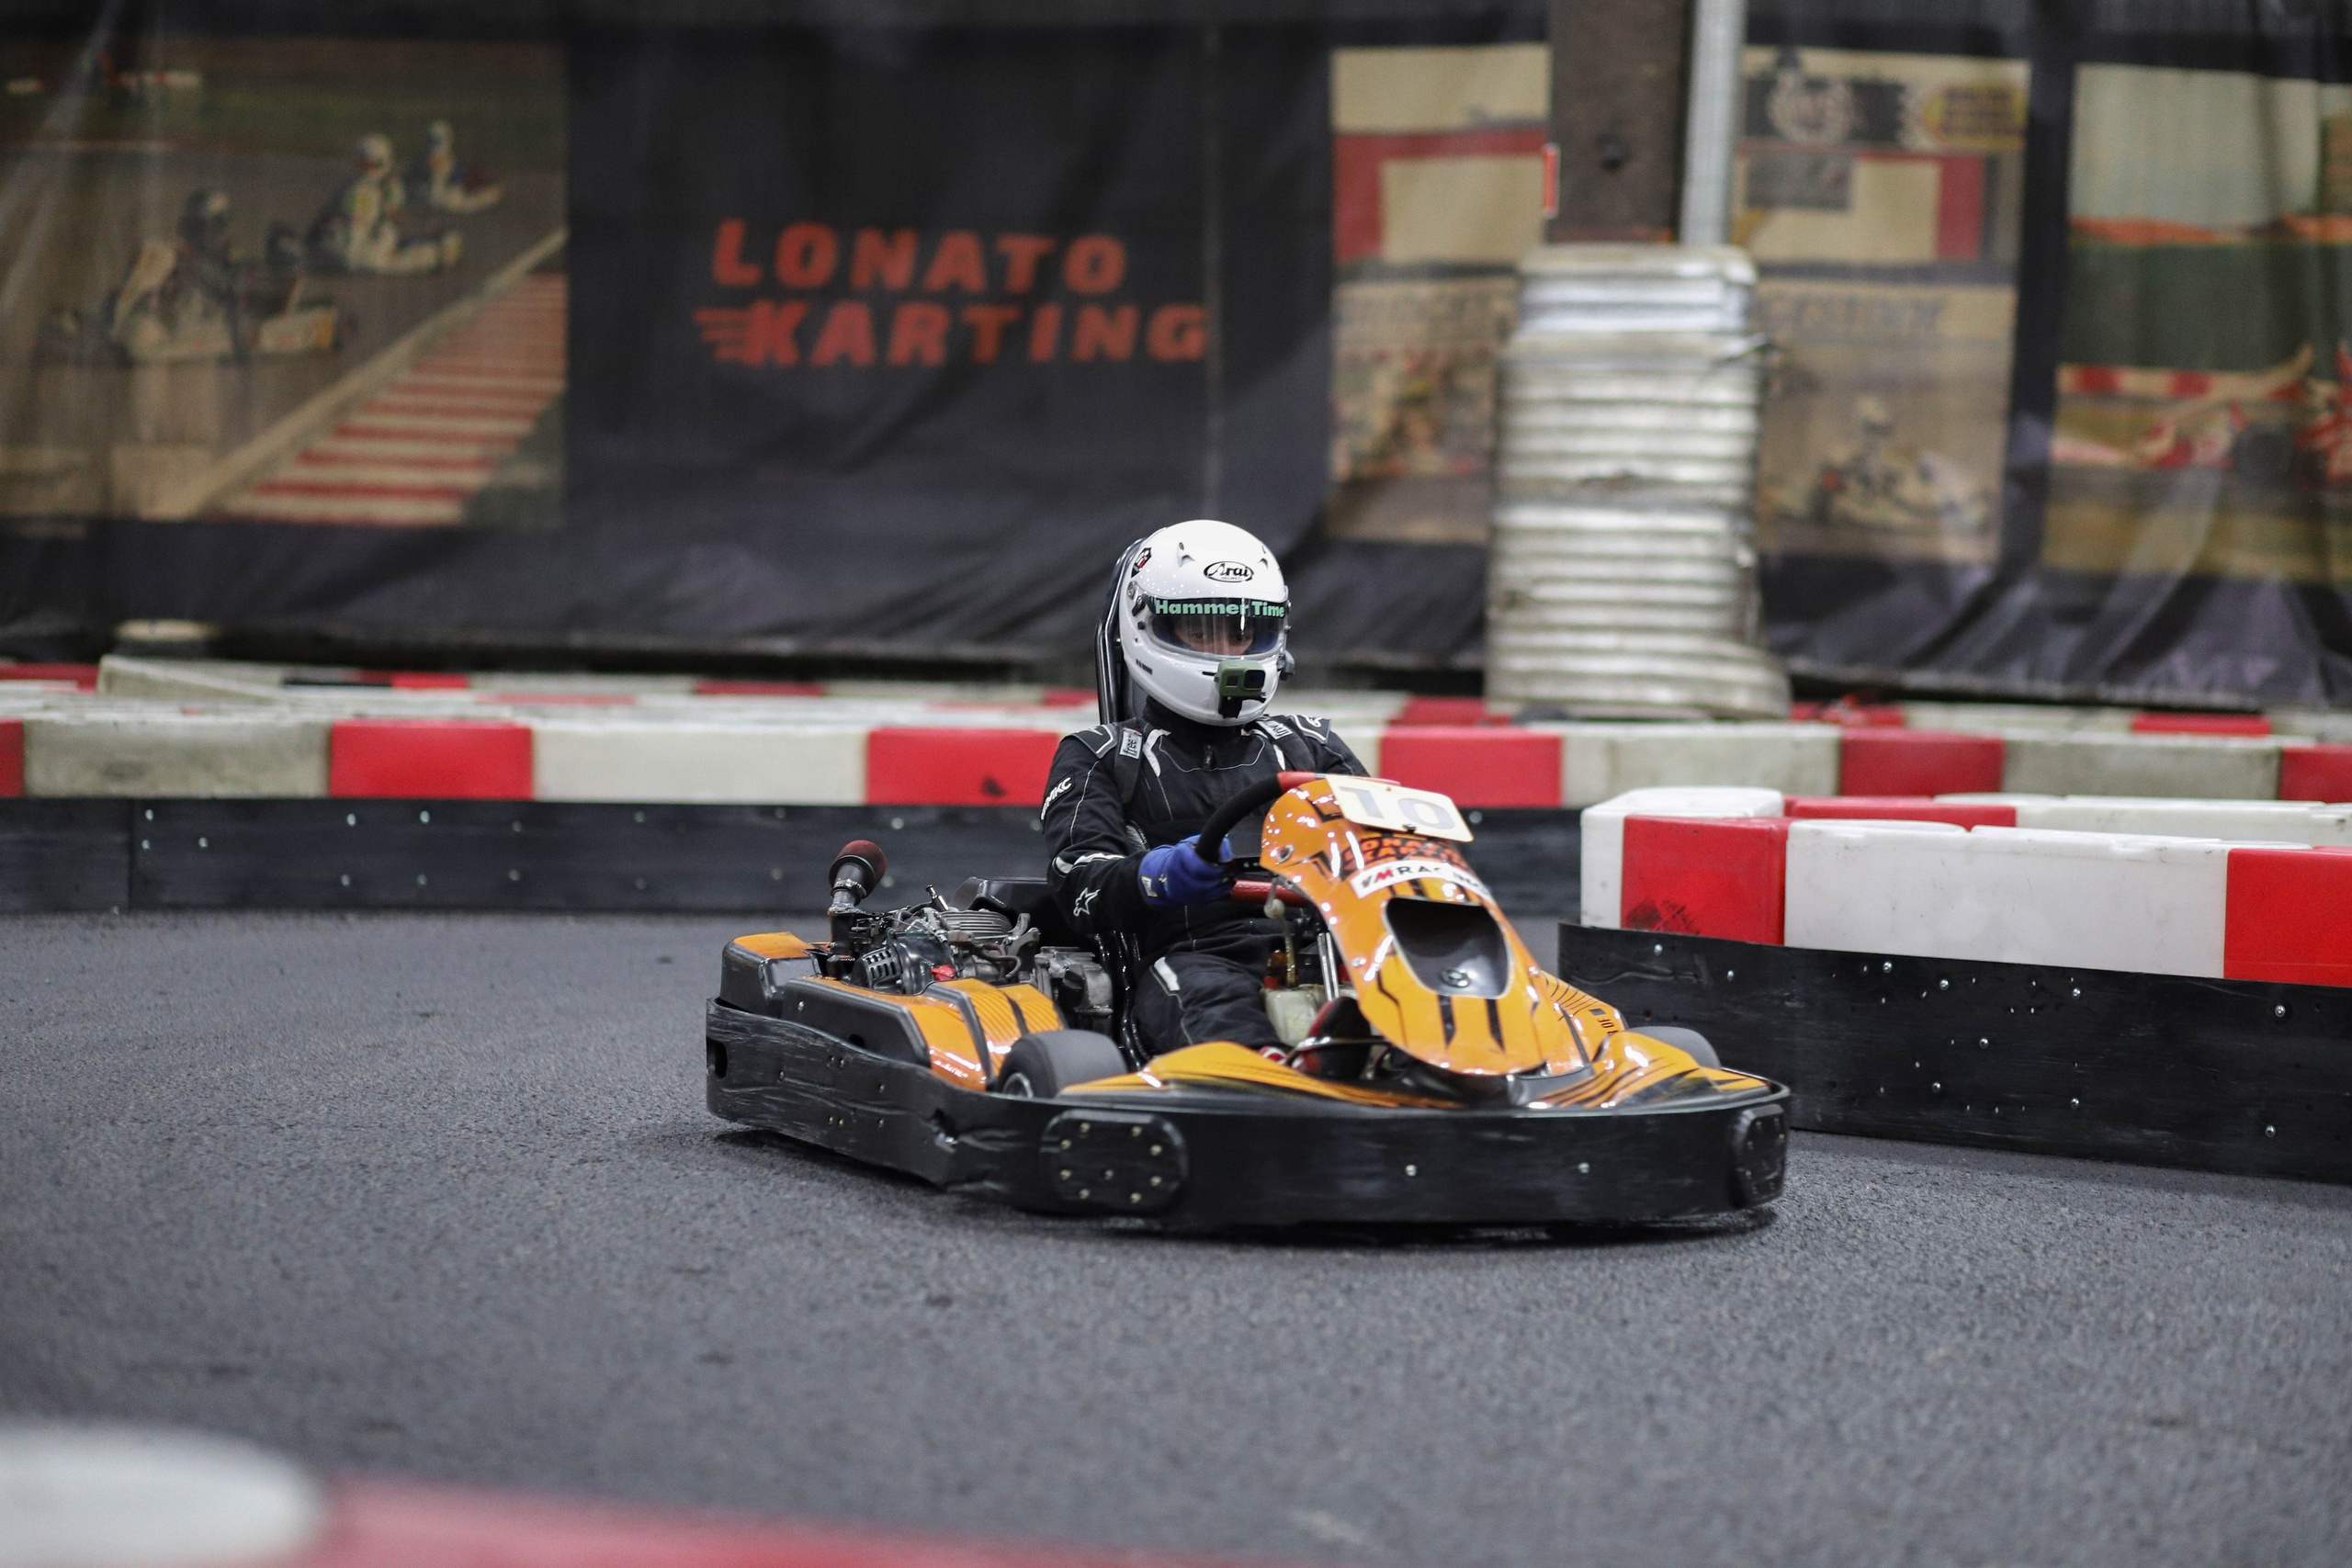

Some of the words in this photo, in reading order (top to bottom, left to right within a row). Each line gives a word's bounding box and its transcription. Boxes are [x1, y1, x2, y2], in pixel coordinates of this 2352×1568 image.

[712, 218, 1127, 294] LONATO
[735, 299, 1209, 367] KARTING
[1207, 562, 1250, 577] Arai
[1155, 599, 1249, 616] Hammer
[1251, 601, 1284, 617] Time
[1339, 785, 1455, 829] 10
